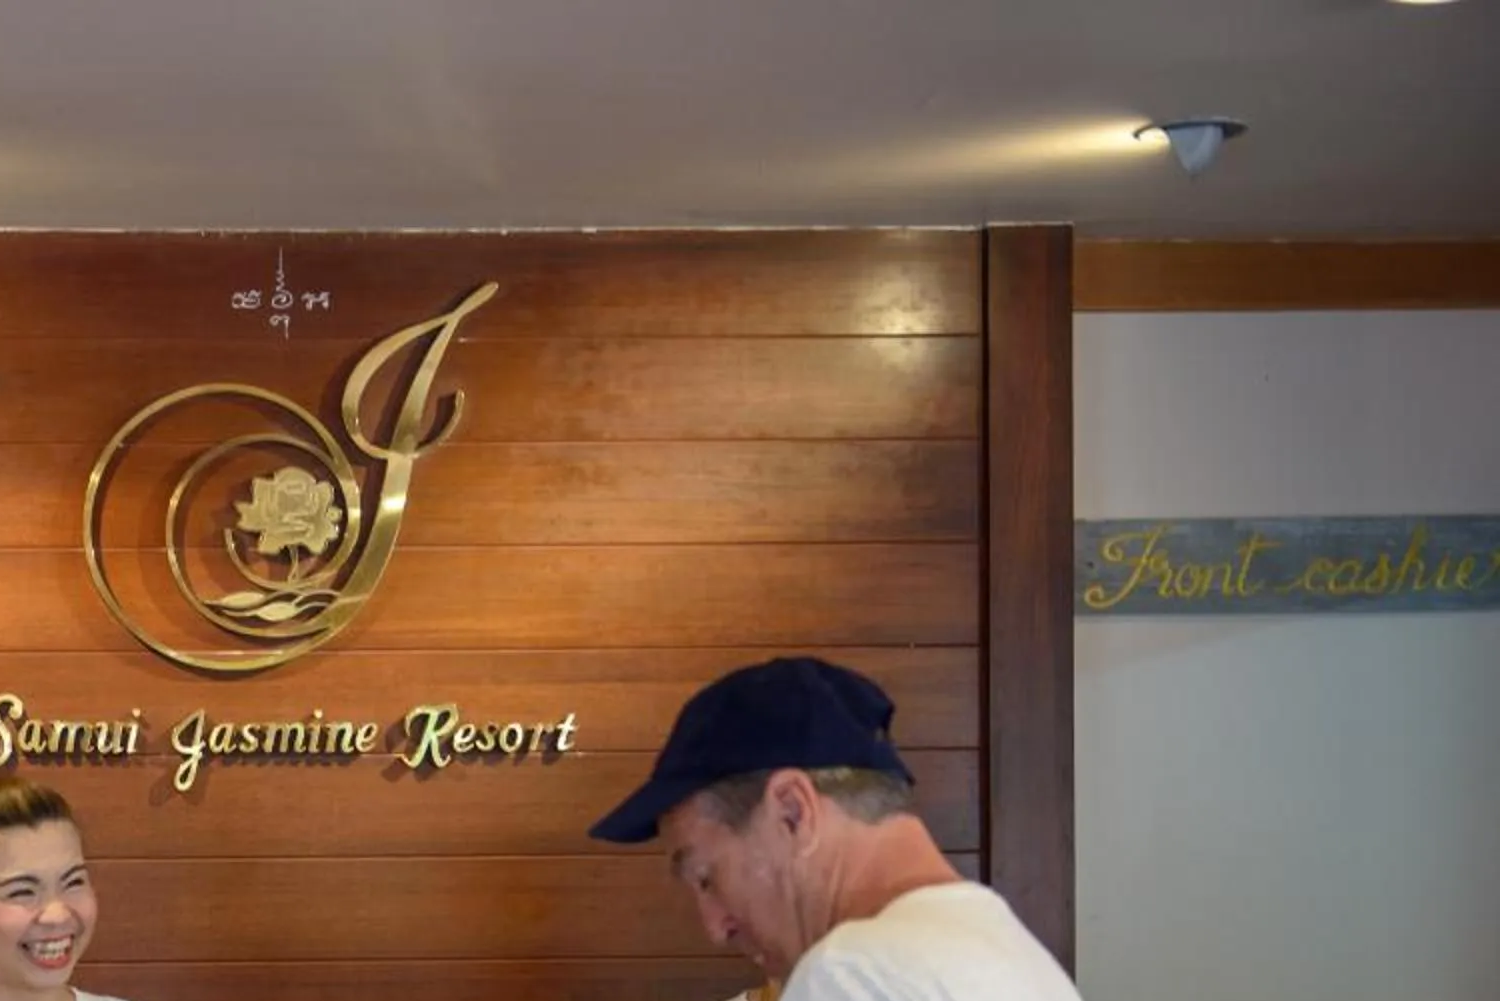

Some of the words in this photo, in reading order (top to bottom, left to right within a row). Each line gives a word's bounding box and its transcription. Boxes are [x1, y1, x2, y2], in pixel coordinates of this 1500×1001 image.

[1084, 522, 1284, 609] Front
[171, 708, 378, 791] Jasmine
[400, 702, 579, 769] Resort
